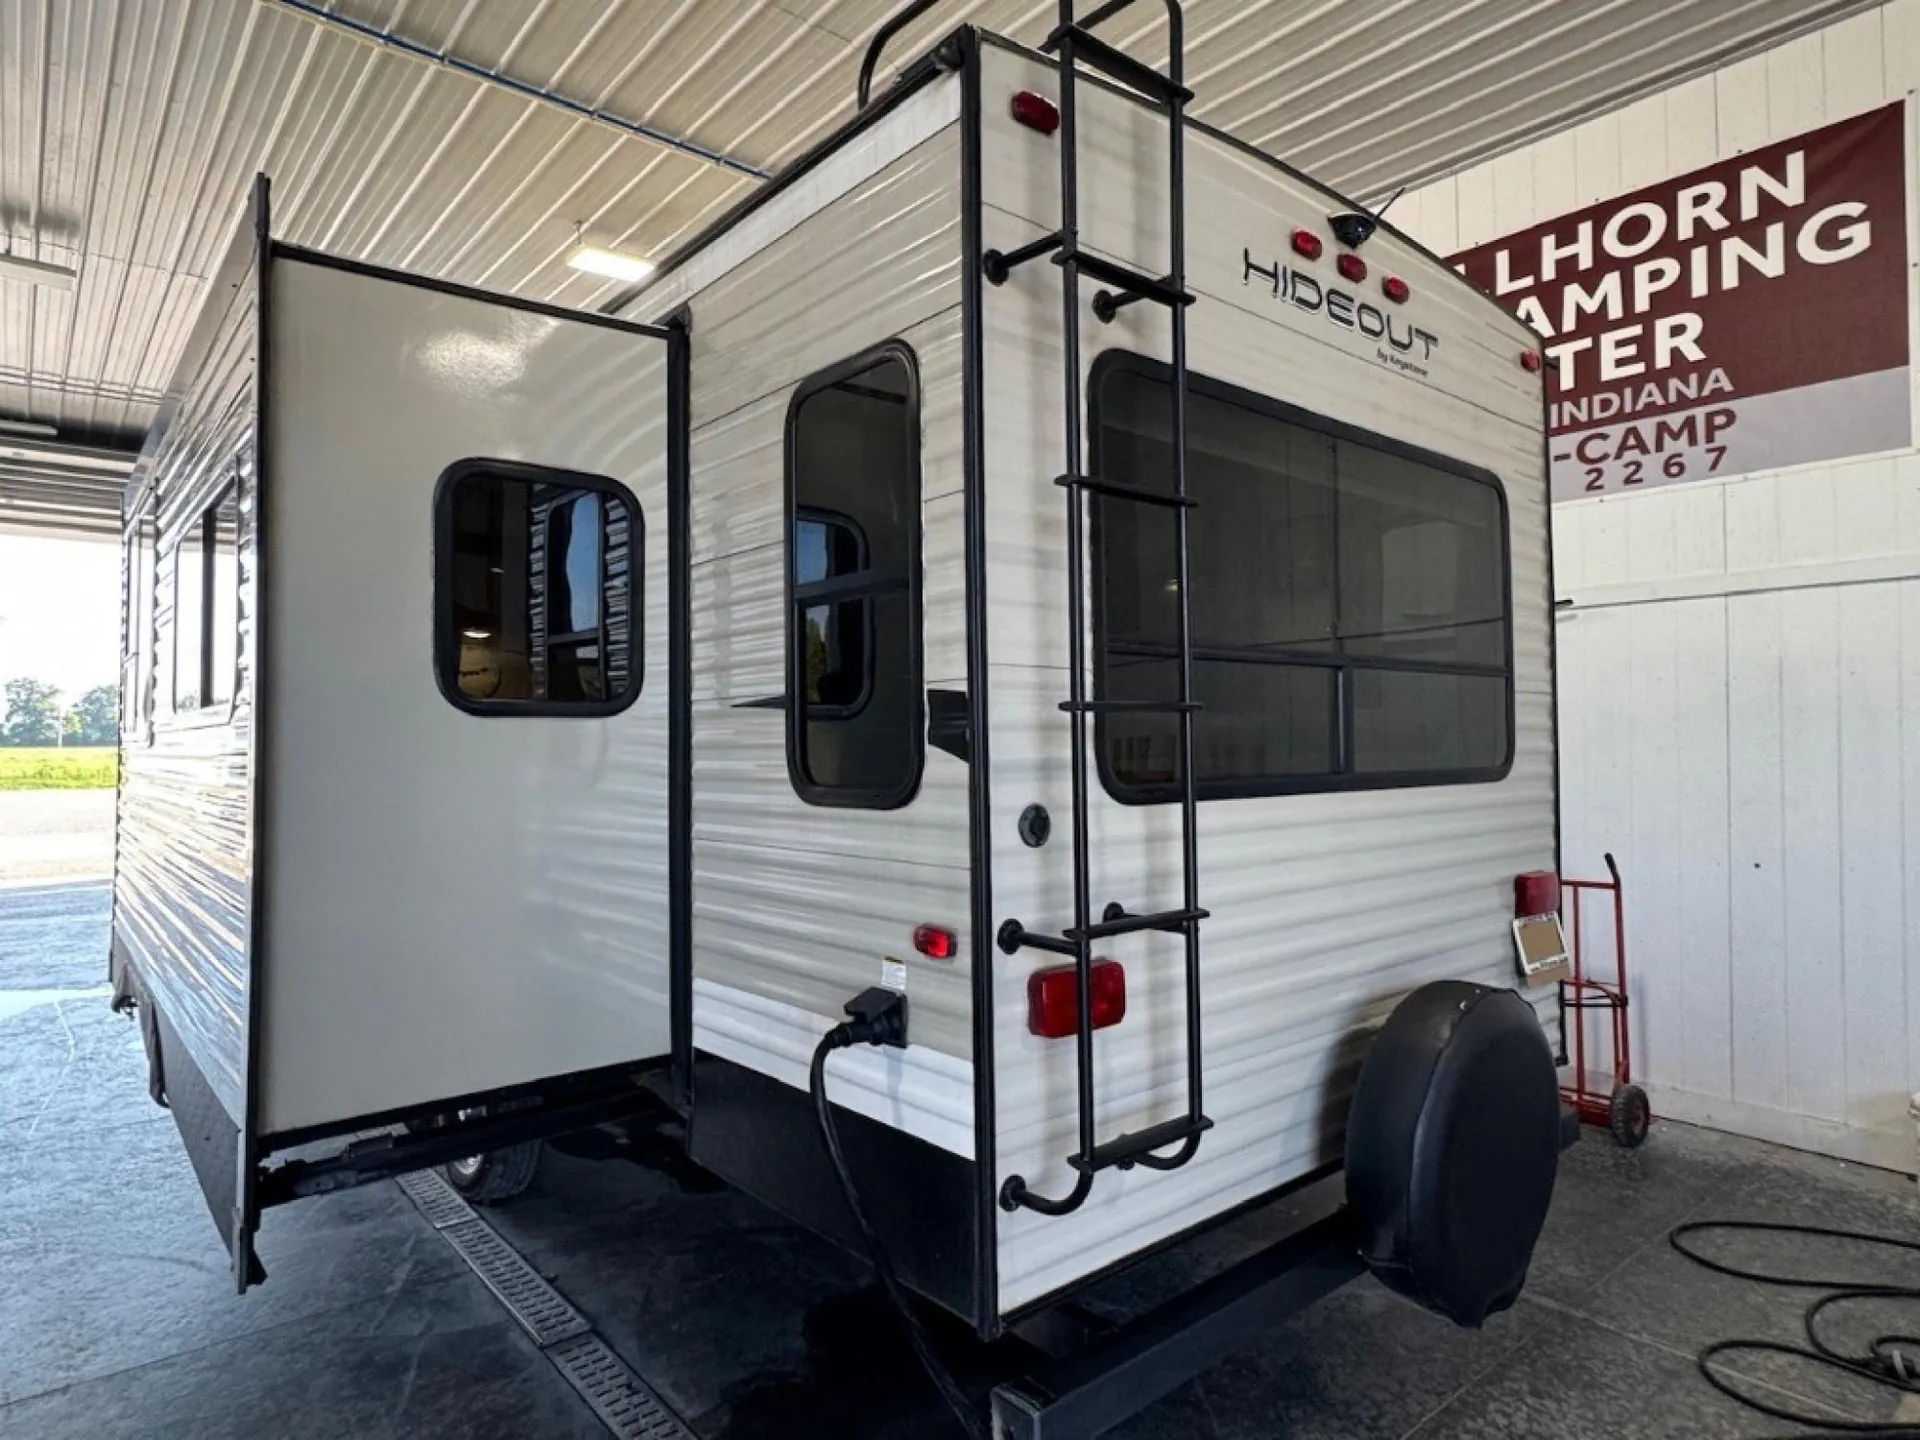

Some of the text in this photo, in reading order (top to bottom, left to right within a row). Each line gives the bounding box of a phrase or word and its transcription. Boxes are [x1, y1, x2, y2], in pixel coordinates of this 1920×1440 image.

[1454, 150, 1804, 296] LHORN
[1243, 247, 1438, 360] HIDEOUT
[1545, 312, 1706, 391] TER
[1550, 367, 1735, 428] INDIANA
